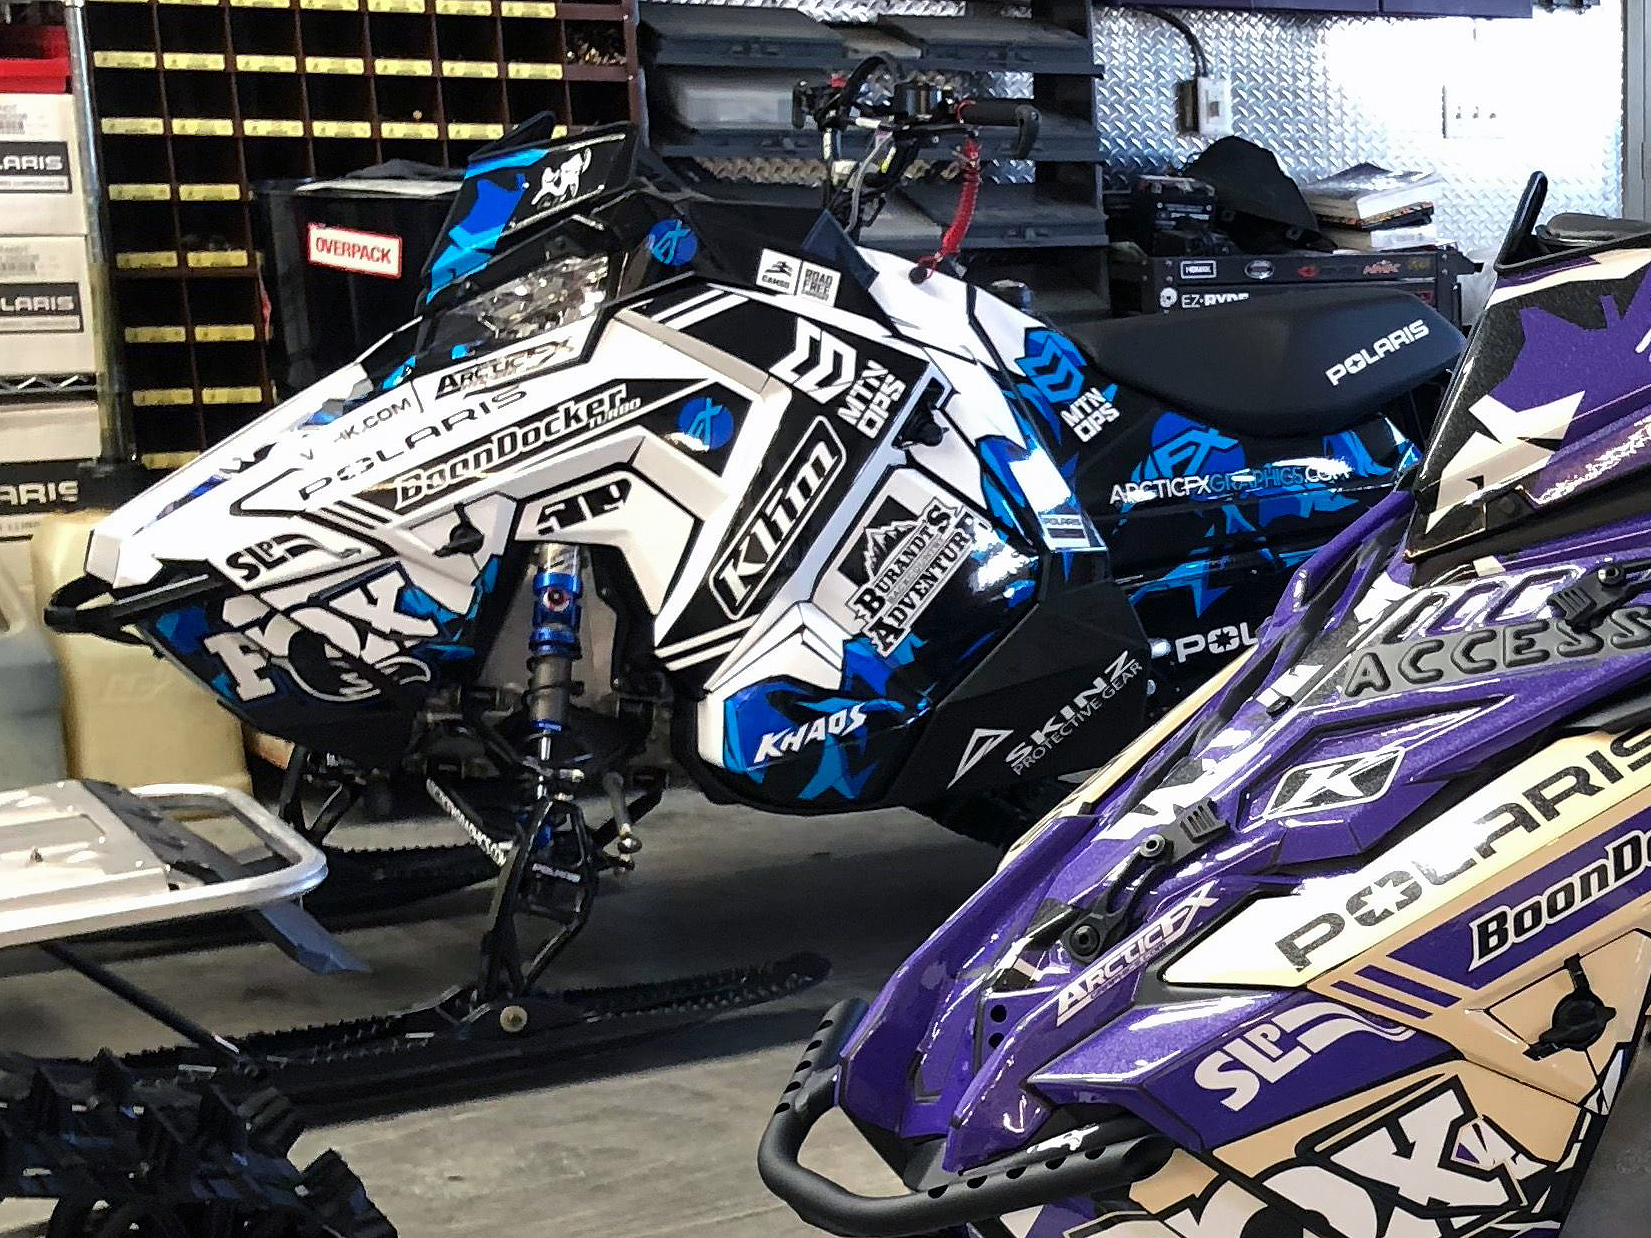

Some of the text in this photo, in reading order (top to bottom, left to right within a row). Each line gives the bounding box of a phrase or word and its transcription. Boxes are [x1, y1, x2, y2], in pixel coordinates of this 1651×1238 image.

[0, 154, 63, 171] ARIS
[316, 237, 391, 264] OVERPACK
[805, 268, 833, 286] ROAD
[803, 278, 830, 296] FREE
[1325, 319, 1430, 386] POLARIS
[837, 359, 889, 426] MTN
[857, 374, 907, 440] OPS
[1061, 387, 1106, 428] MTN
[1073, 401, 1120, 443] OPS
[298, 386, 527, 500] POLARIS
[395, 384, 628, 510] BoonDocker
[204, 569, 439, 701] FOX
[753, 702, 868, 764] KHAOS
[1005, 650, 1129, 768] SKINZ
[1013, 658, 1143, 776] PROTECTIVE GEAR
[1056, 880, 1219, 1027] ARCTICFX
[1194, 1005, 1345, 1111] SLP
